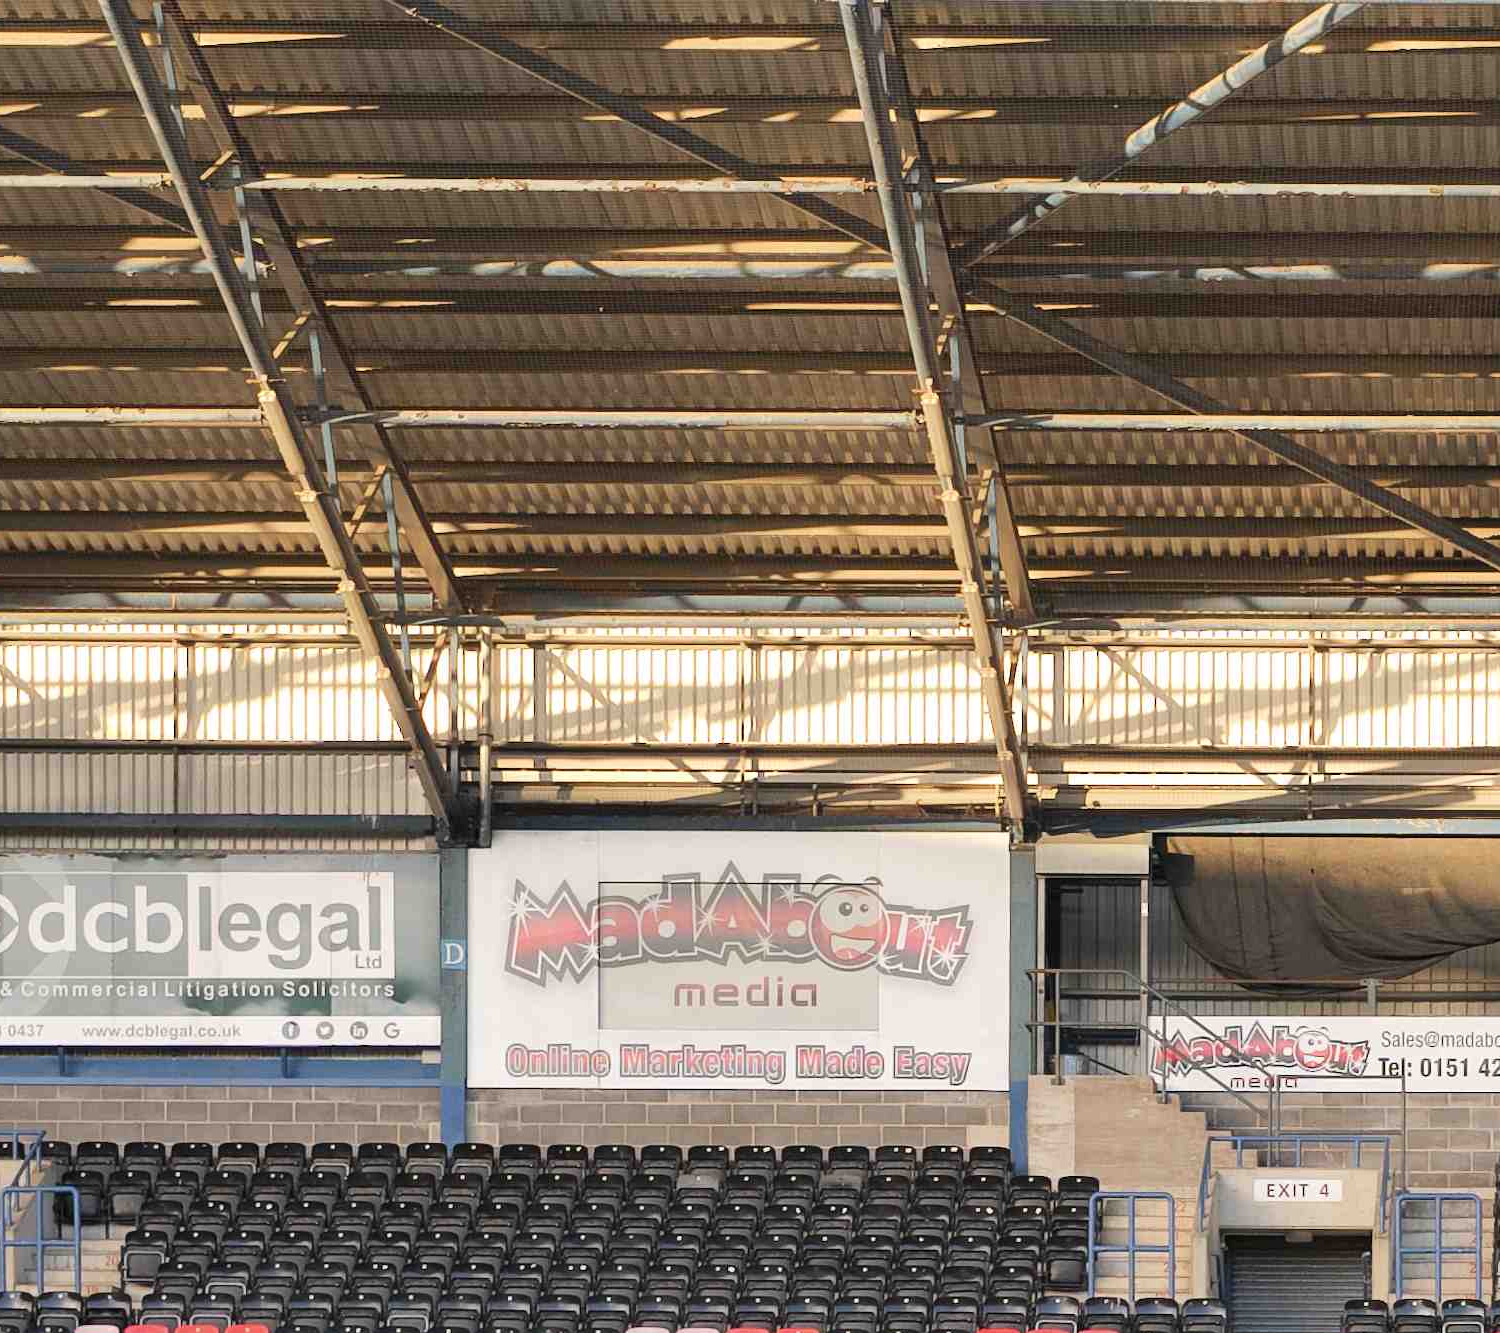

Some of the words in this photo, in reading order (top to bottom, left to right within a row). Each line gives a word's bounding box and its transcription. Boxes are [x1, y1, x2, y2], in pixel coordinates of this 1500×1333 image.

[355, 954, 382, 969] Ltd
[443, 943, 464, 964] D
[0, 981, 14, 998] &
[20, 980, 161, 998] Commercial
[165, 980, 274, 1001] Litigation
[282, 980, 395, 998] Solicitors
[674, 976, 818, 1008] media
[7, 1024, 44, 1038] 0437
[82, 1023, 242, 1040] www.dcblegal.co.uk
[505, 1043, 611, 1078] Online
[619, 1043, 786, 1084] Marketing
[797, 1044, 884, 1079] Made
[893, 1045, 972, 1085] Easy
[1378, 1056, 1412, 1077] Tel:
[1419, 1056, 1469, 1078] 0151
[1267, 1183, 1309, 1198] EXIT
[1319, 1183, 1329, 1198] 4
